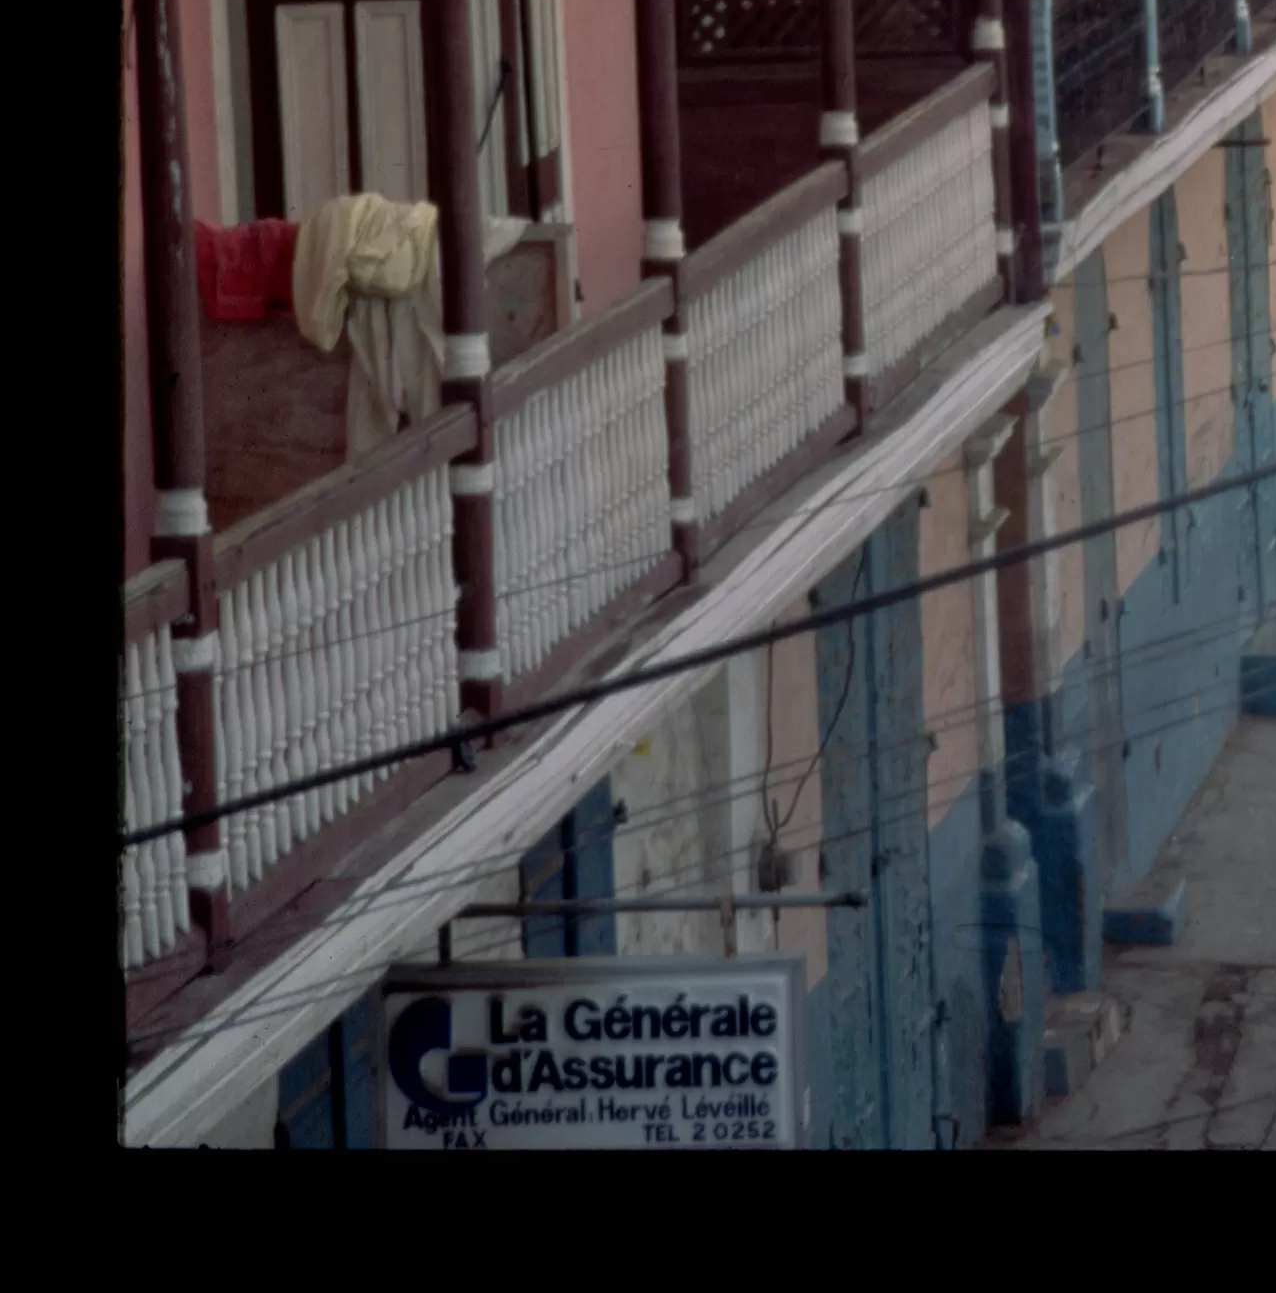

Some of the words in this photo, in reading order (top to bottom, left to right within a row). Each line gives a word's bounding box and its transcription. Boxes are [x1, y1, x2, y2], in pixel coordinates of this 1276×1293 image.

[489, 996, 547, 1044] La
[564, 993, 778, 1040] Générale
[491, 1049, 778, 1093] d'Assurance
[404, 1104, 478, 1133] Agent
[599, 1095, 672, 1123] Hervé
[443, 1131, 487, 1149] FAX
[643, 1124, 681, 1142] TEL
